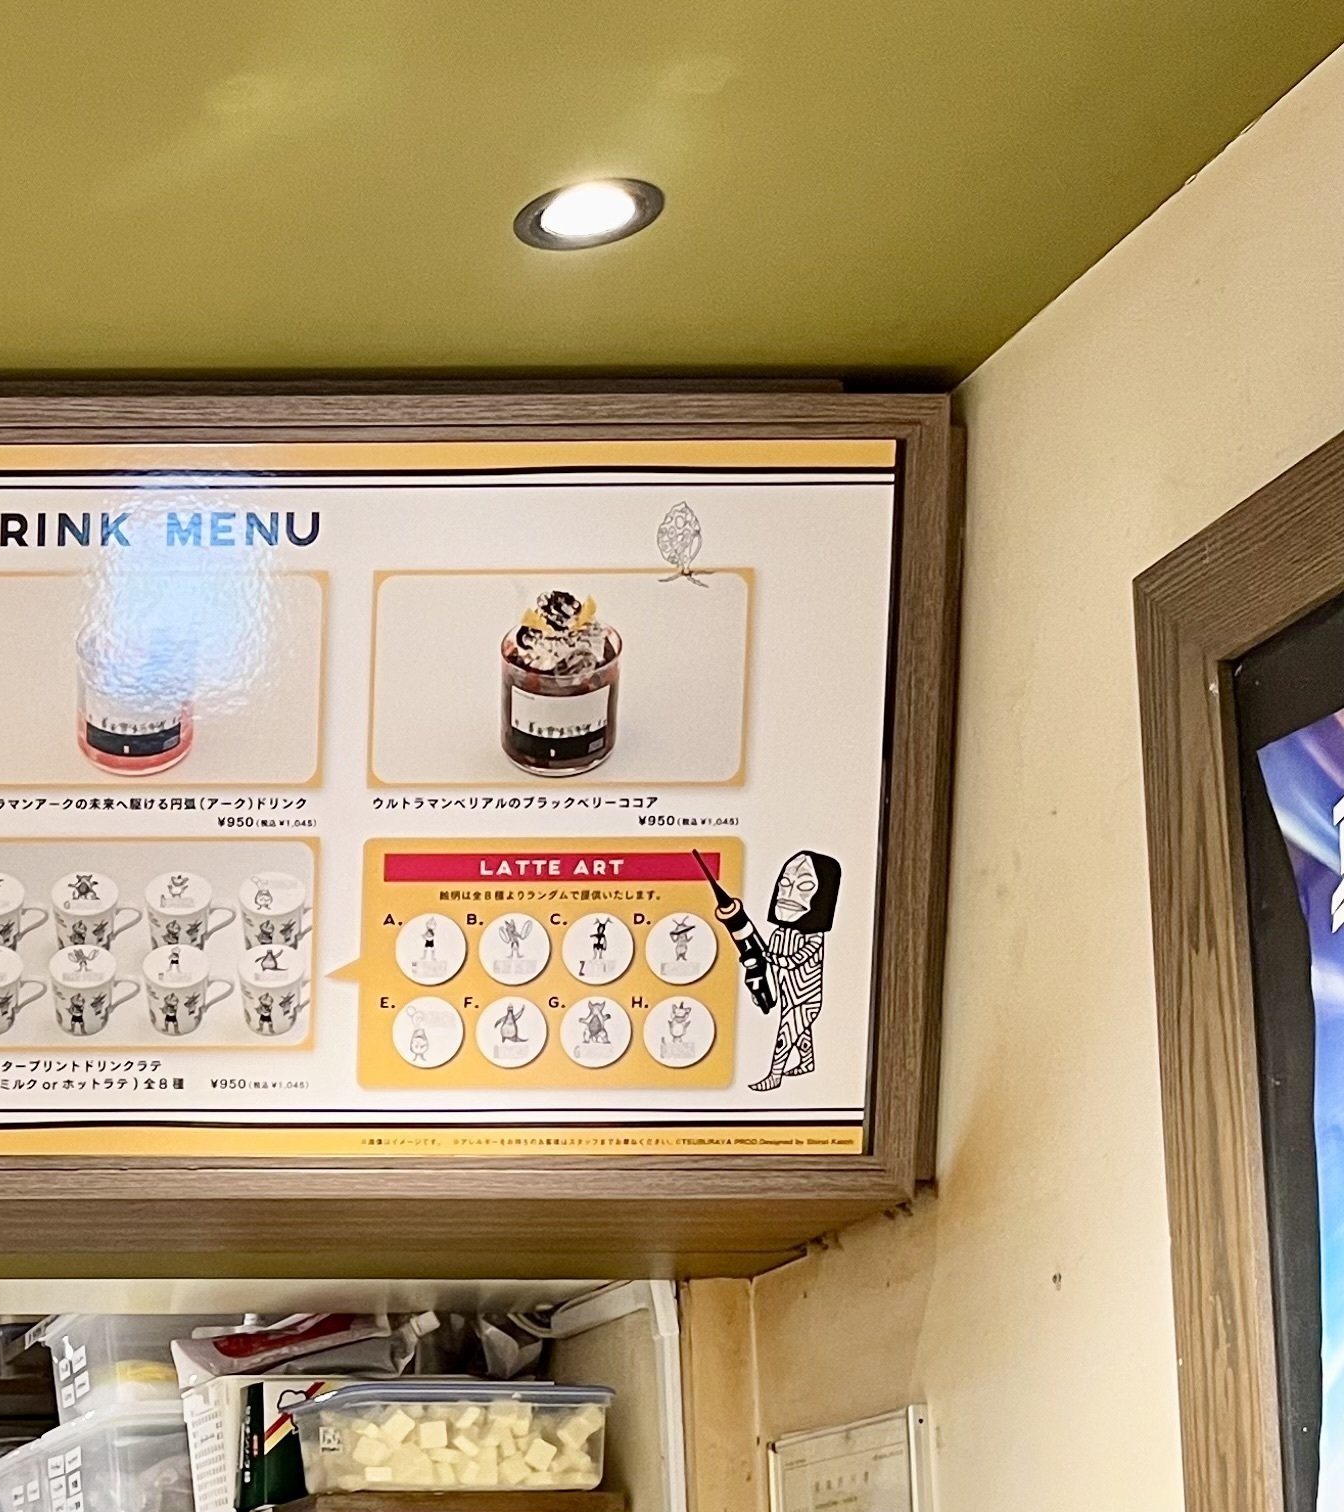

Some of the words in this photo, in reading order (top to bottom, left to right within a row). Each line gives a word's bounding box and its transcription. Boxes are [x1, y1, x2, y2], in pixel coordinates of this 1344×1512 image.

[166, 511, 322, 547] MENU
[217, 816, 254, 829] ¥950
[638, 815, 676, 827] ¥950
[479, 859, 561, 876] LATTE
[573, 859, 625, 875] ART
[42, 1080, 59, 1091] or
[210, 1078, 247, 1091] ¥950
